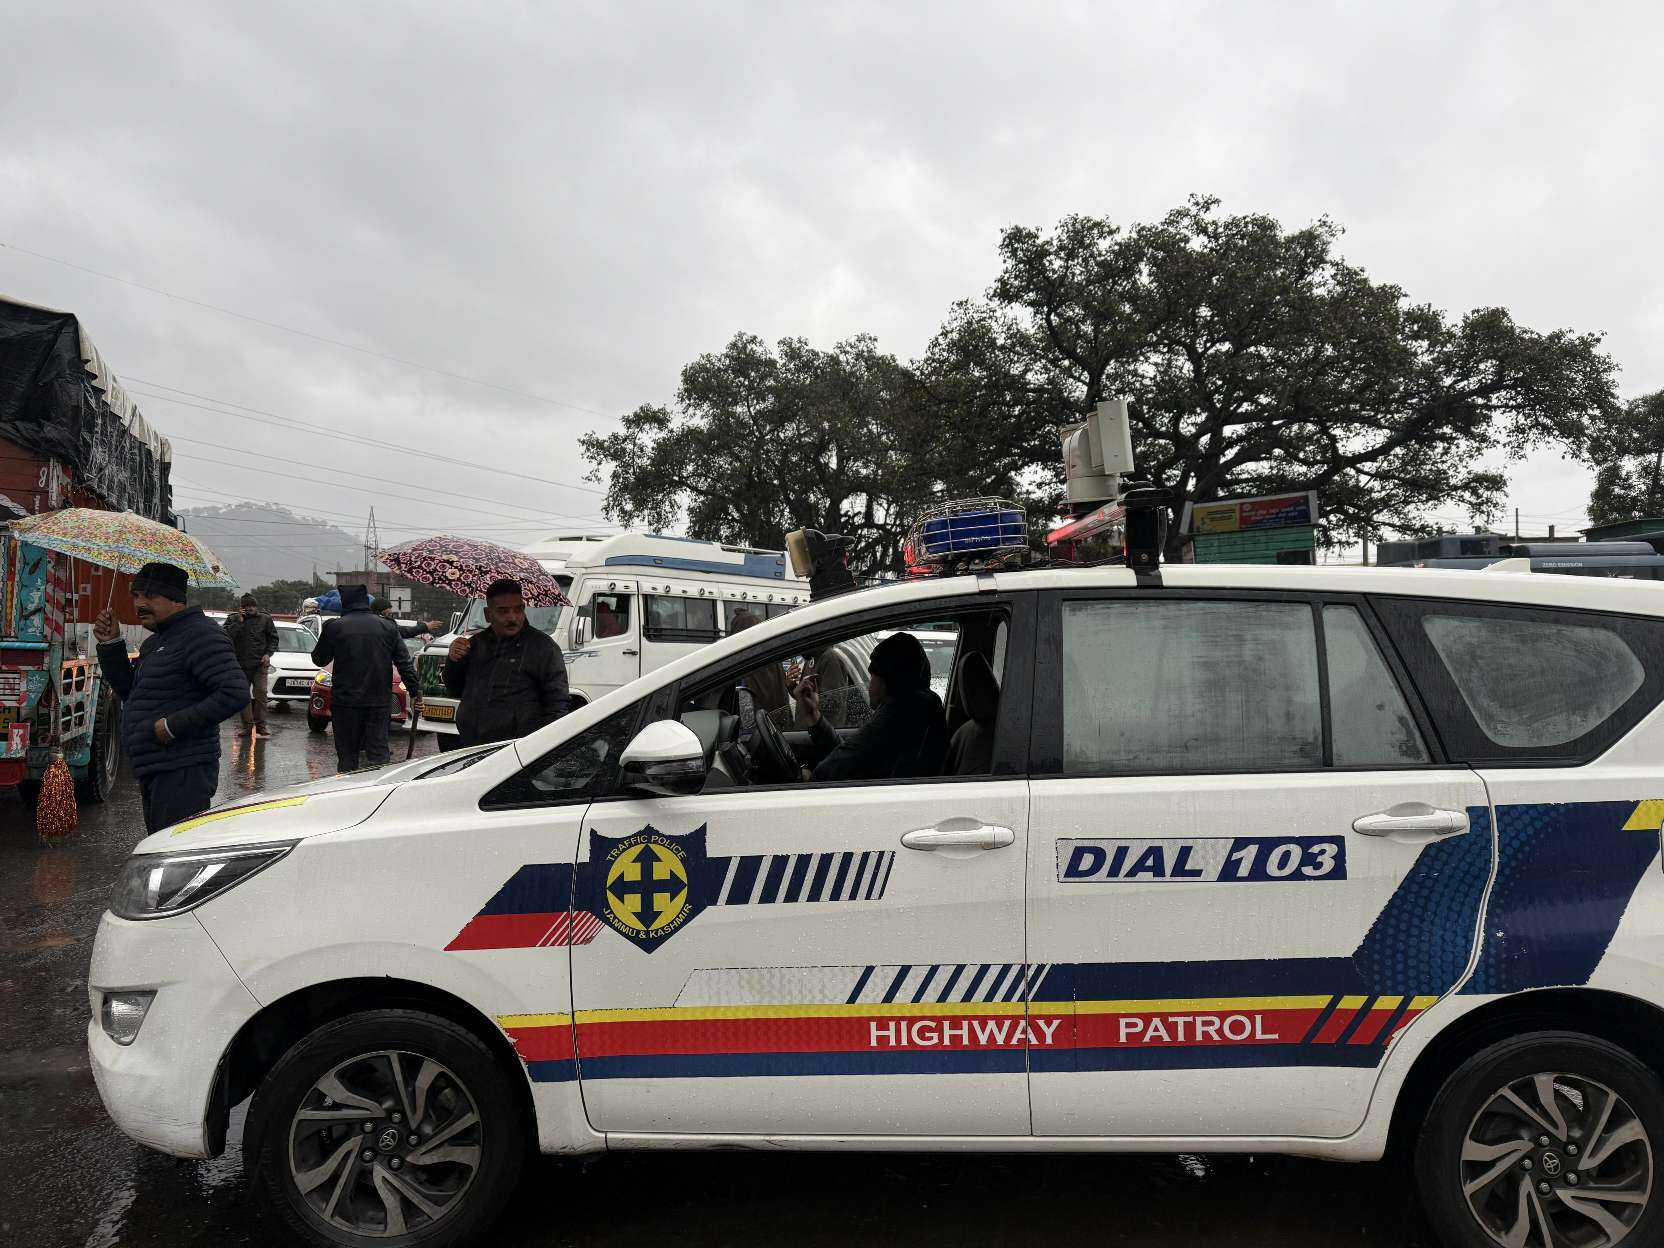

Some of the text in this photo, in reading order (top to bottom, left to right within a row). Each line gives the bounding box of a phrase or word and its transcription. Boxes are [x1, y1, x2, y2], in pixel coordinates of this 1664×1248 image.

[606, 835, 687, 861] TRAFFIC POLICE
[1063, 843, 1339, 878] DIAL 103
[603, 902, 693, 939] JAMMU & KASHMIR
[869, 1014, 1280, 1048] HIGHWAY PATROL
